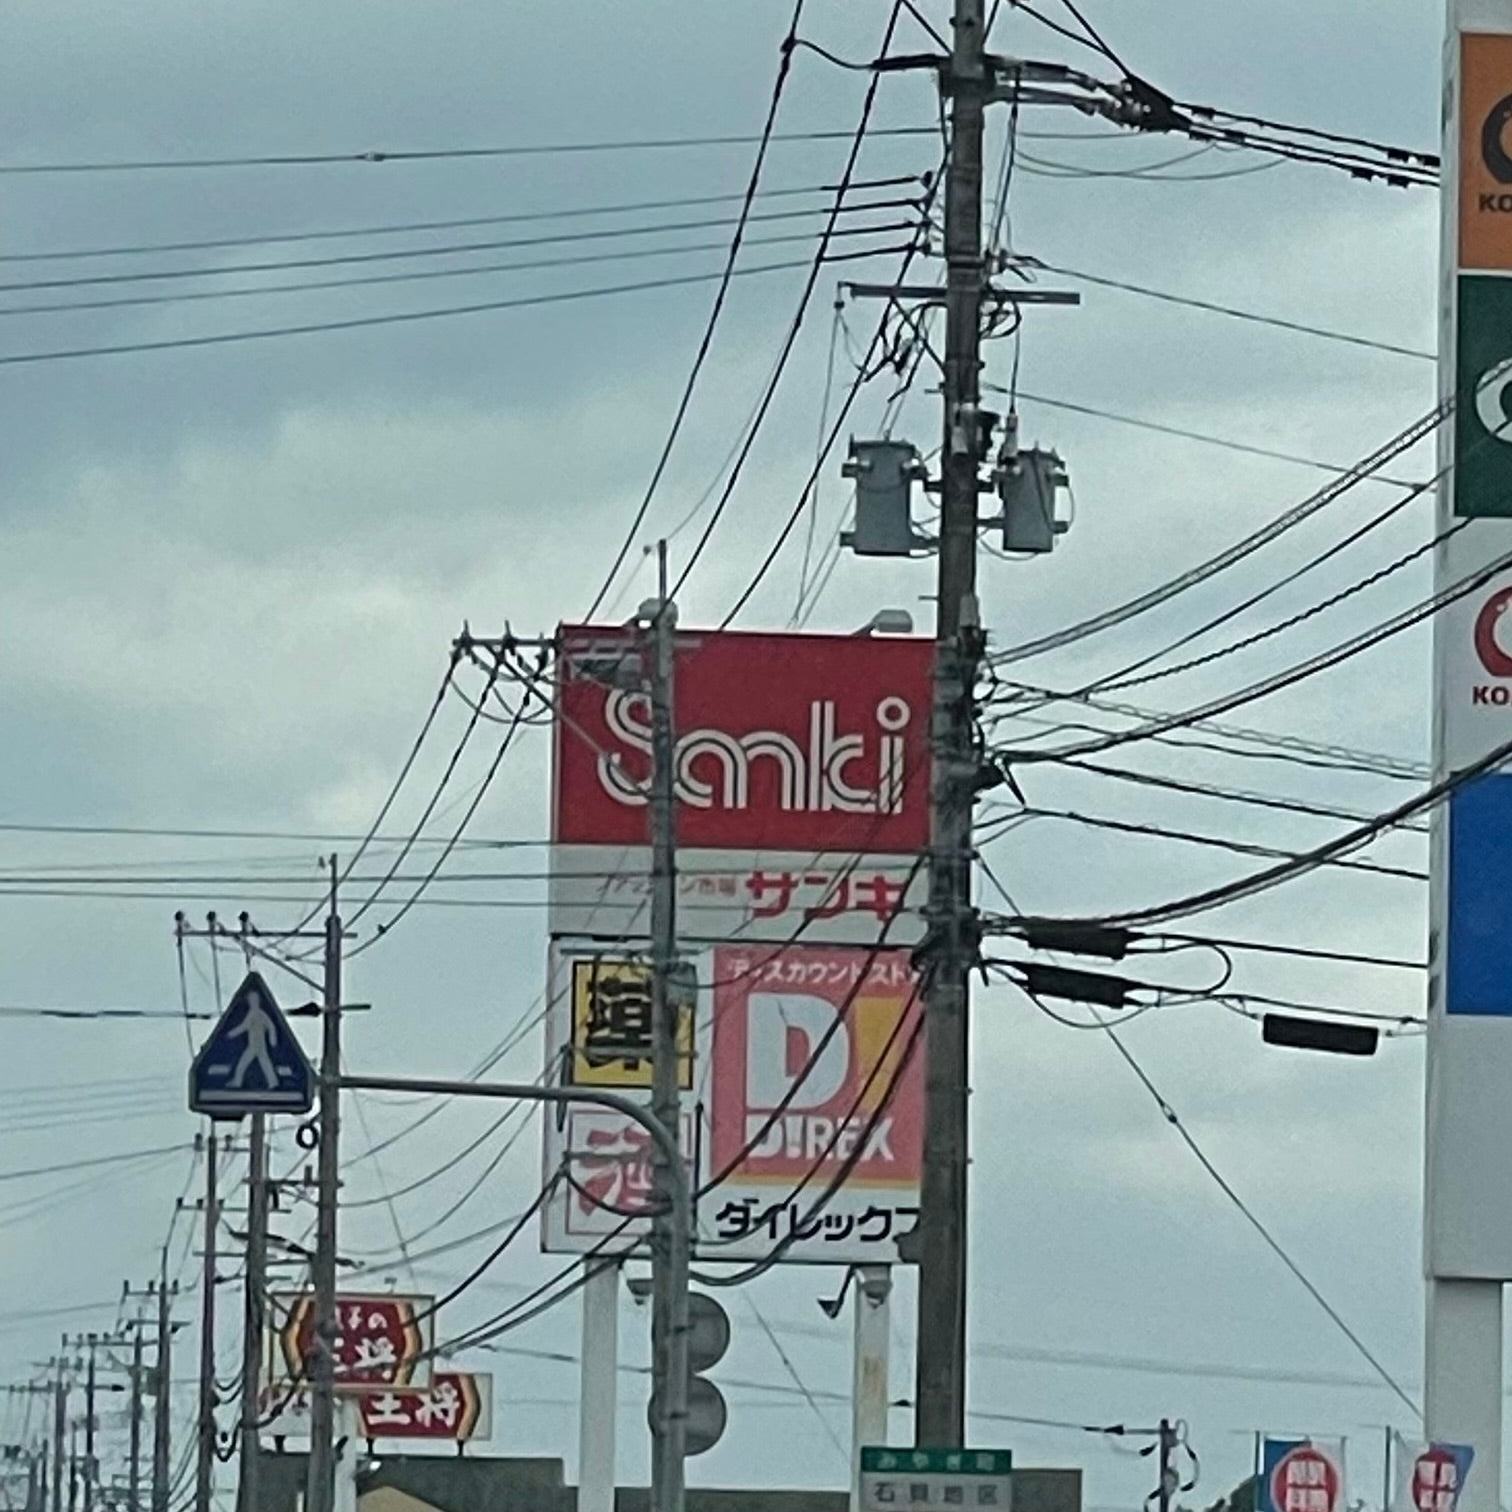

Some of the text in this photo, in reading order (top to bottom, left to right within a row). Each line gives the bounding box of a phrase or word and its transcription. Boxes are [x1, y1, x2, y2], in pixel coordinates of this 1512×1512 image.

[598, 688, 911, 815] Sanki
[746, 871, 907, 921] サンキ
[334, 1306, 388, 1331] 子の
